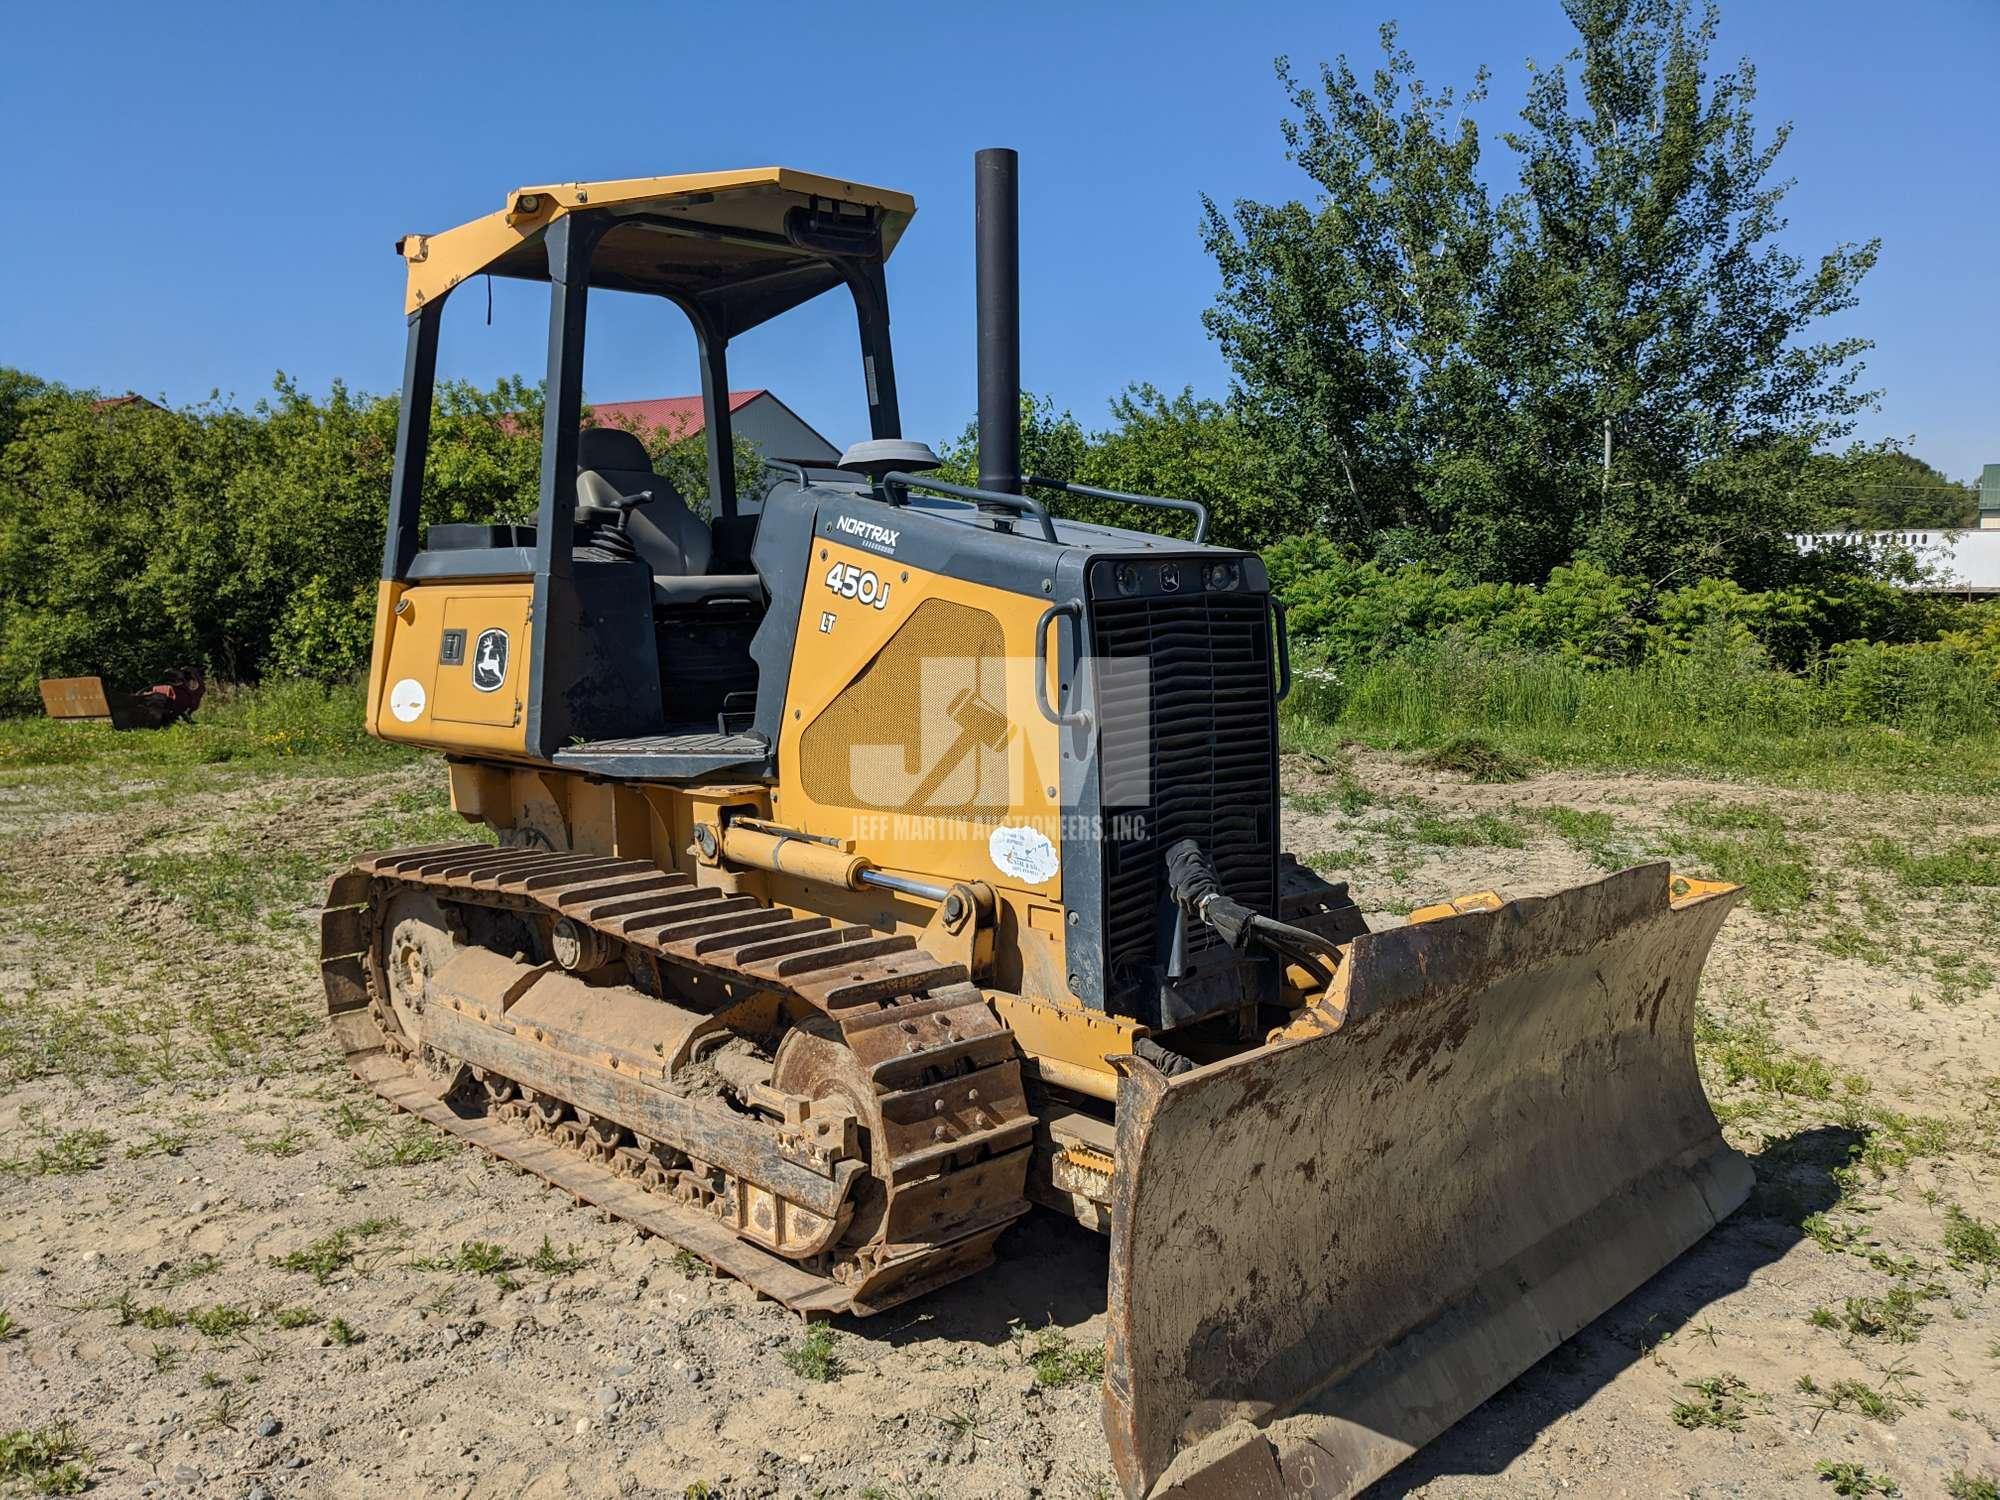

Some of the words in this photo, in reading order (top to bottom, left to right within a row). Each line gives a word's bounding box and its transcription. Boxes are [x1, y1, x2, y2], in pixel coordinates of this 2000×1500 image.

[836, 515, 900, 547] NORTRAX
[825, 561, 890, 610] 450J
[819, 611, 837, 633] LT
